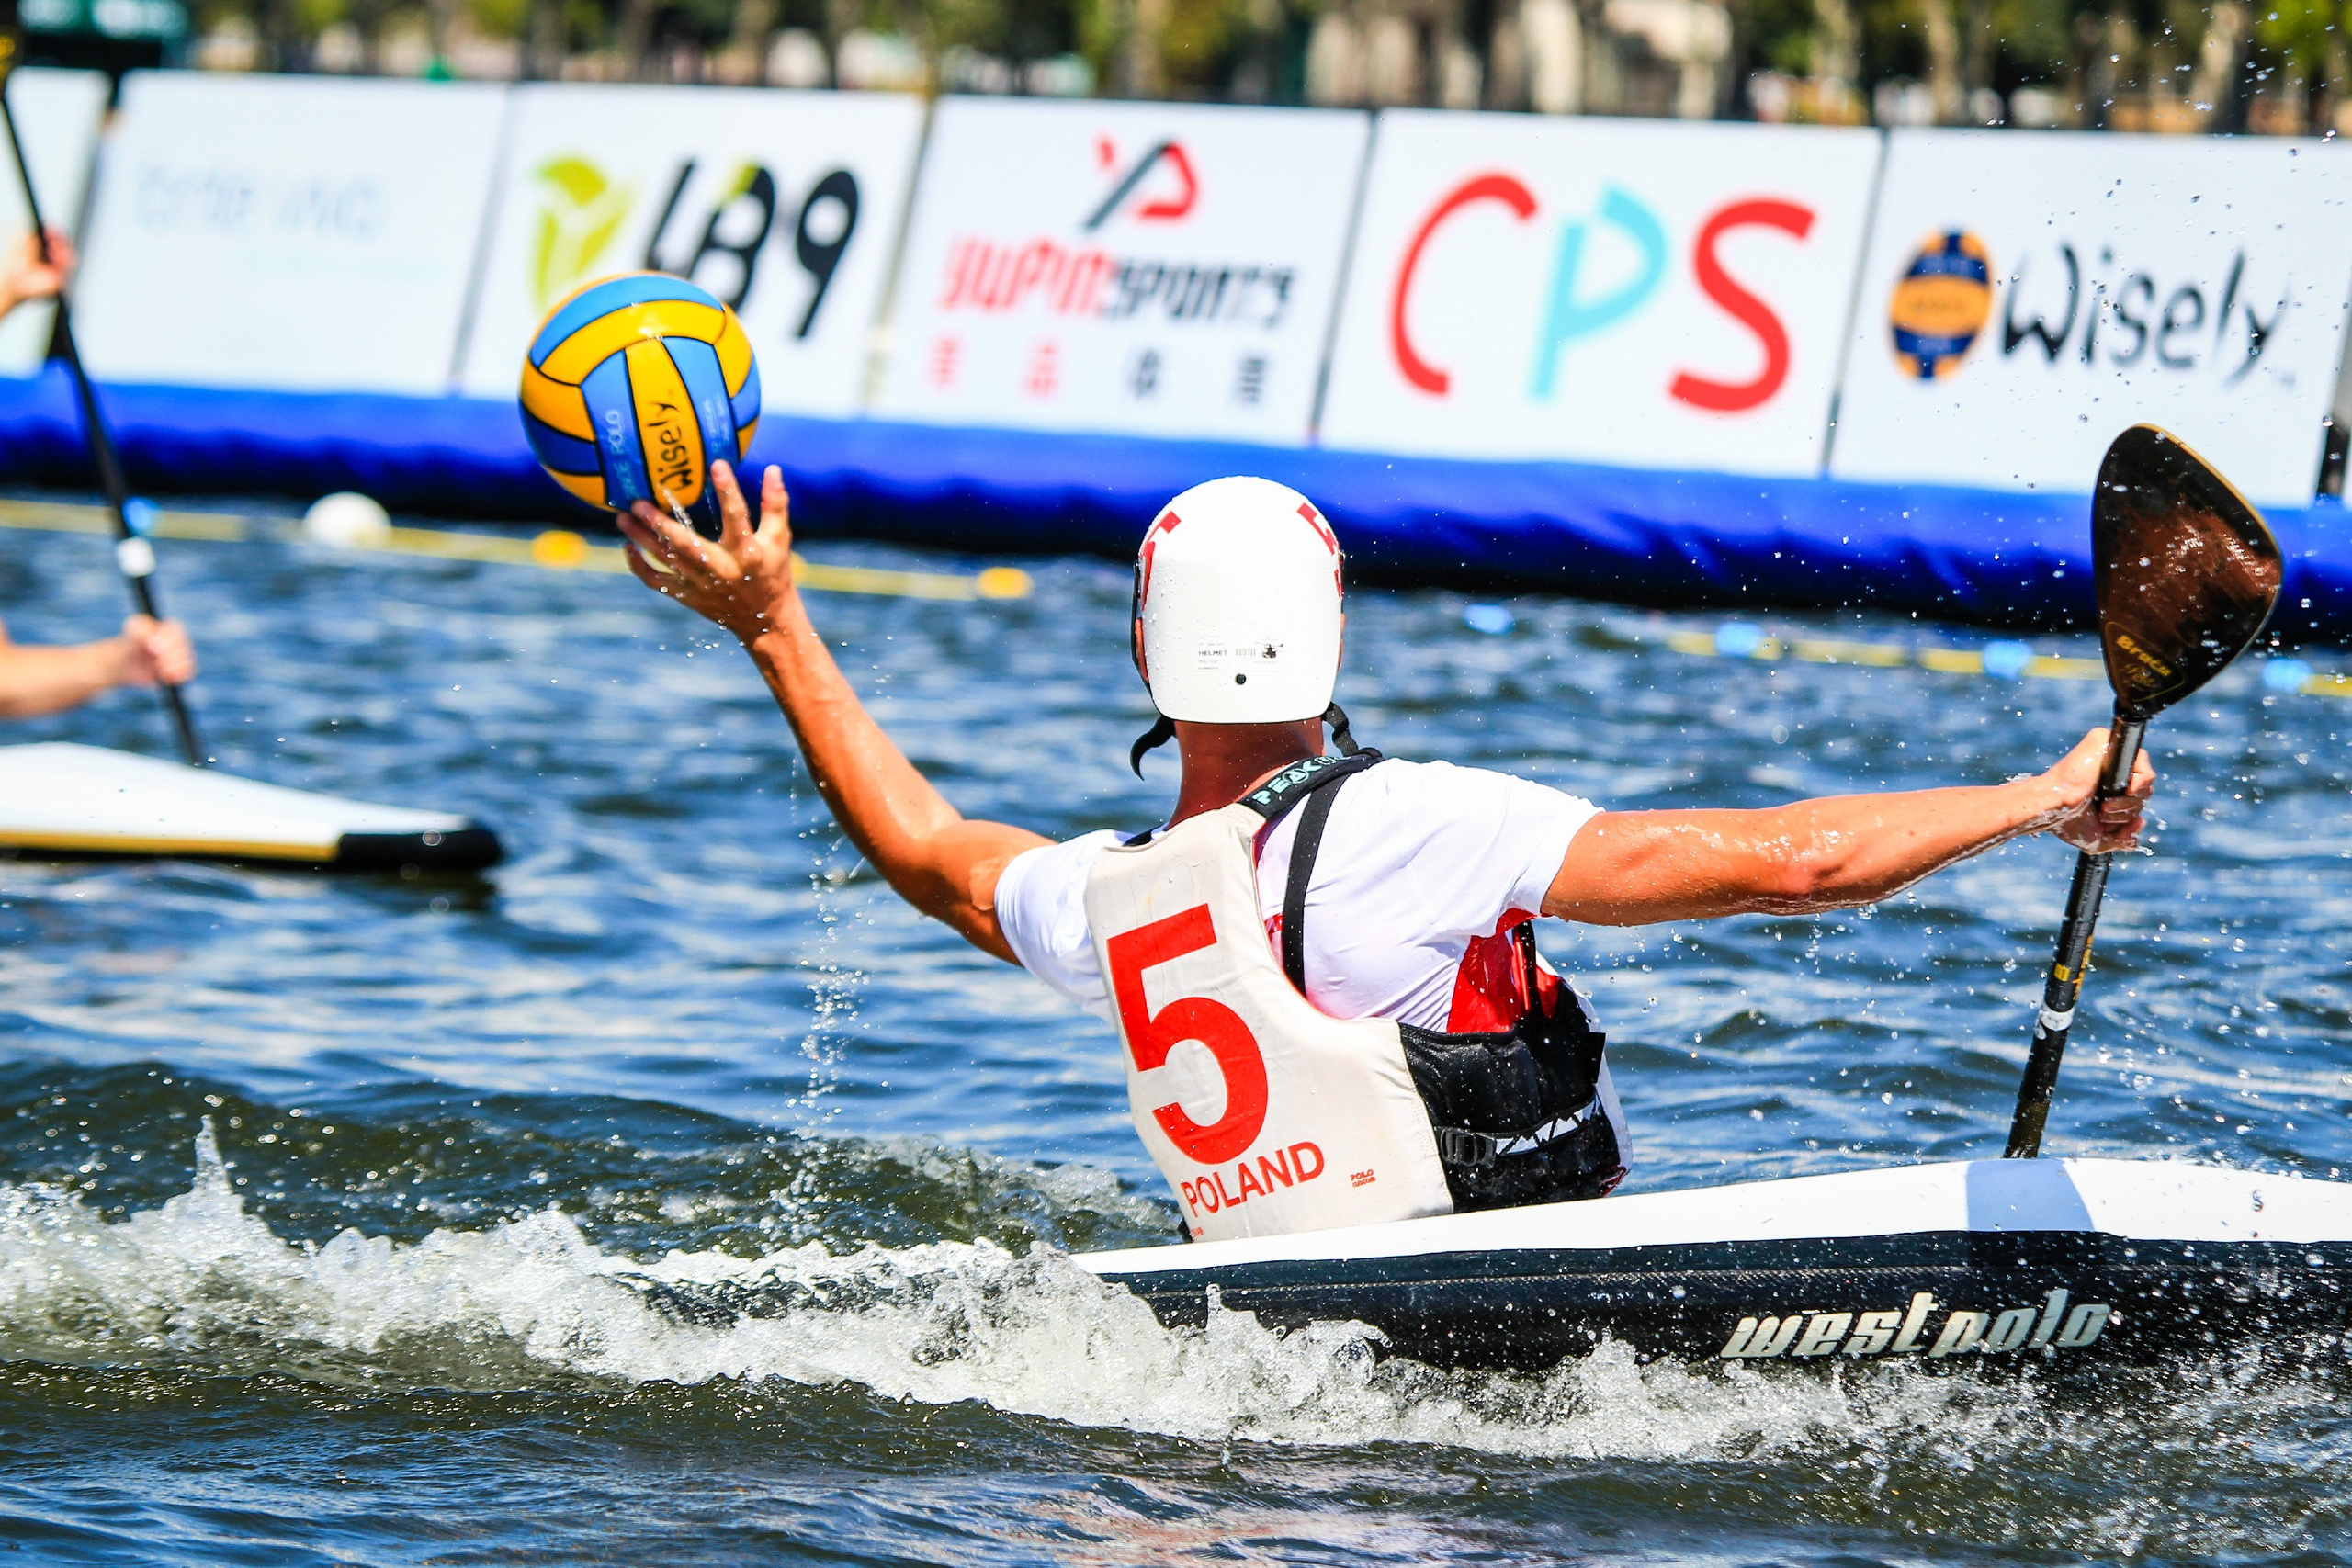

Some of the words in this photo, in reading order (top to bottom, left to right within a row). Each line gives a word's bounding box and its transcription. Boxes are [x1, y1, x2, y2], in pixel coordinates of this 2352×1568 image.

[1392, 173, 1815, 412] CPS
[2001, 239, 2291, 386] Wisely
[605, 410, 625, 455] POLO
[647, 401, 694, 491] Wisely
[1106, 903, 1268, 1165] 5
[1180, 1141, 1325, 1218] POLAND
[1351, 1168, 1374, 1181] POLO
